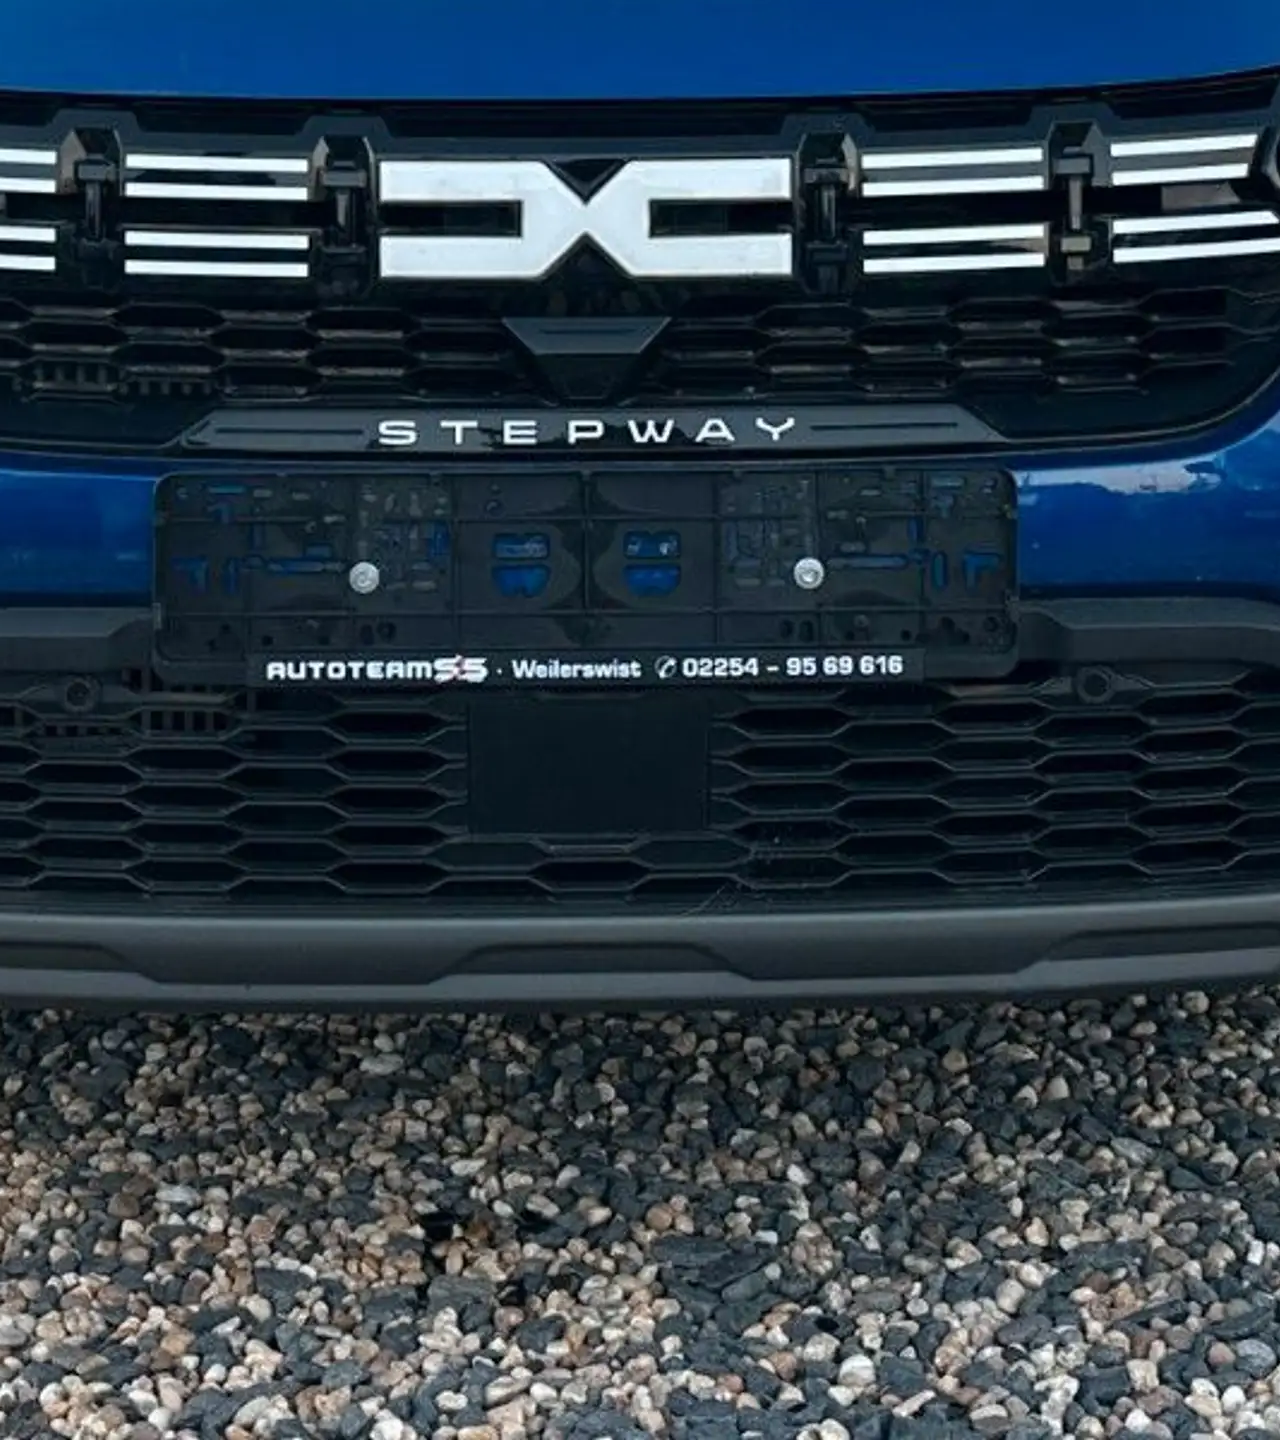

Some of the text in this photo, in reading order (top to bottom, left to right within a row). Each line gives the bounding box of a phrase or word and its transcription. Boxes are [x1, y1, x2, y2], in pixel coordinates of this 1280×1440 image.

[378, 417, 796, 446] STEPWAY
[511, 658, 642, 679] Weilerswist
[682, 657, 760, 678] 02254
[786, 656, 817, 676] 95
[822, 655, 854, 676] 69
[859, 655, 904, 675] 616
